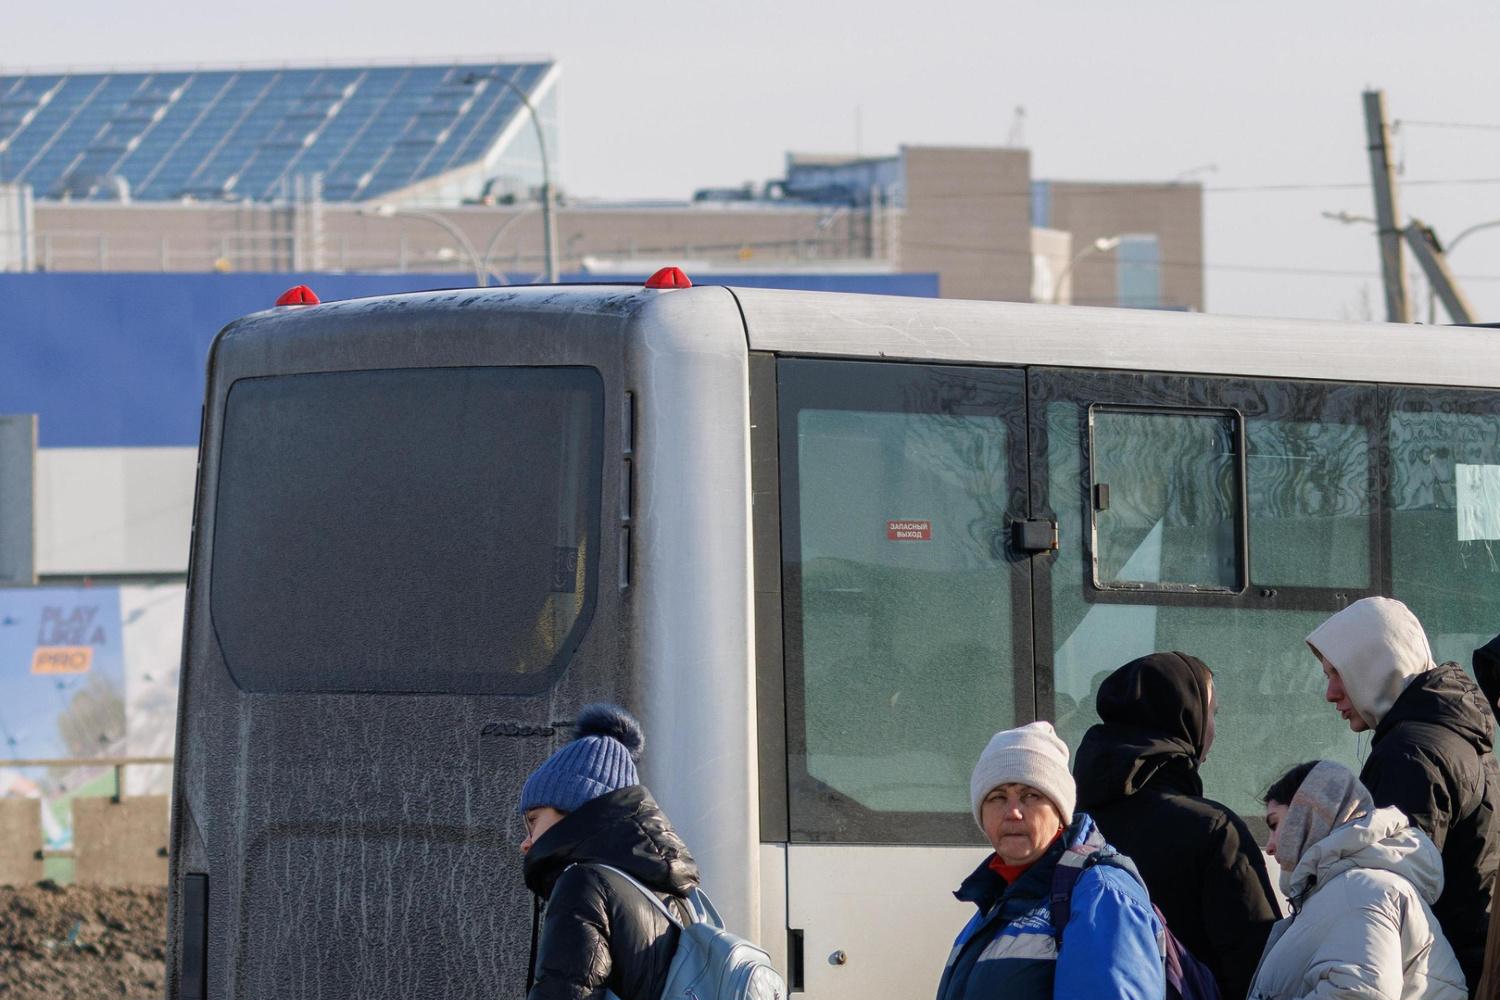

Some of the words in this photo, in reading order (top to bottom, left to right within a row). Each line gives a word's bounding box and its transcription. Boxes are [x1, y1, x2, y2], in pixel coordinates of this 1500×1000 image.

[890, 522, 928, 530] ЗАПАСНЫЙ
[896, 531, 922, 539] ВЫХОД
[35, 651, 88, 670] PRO
